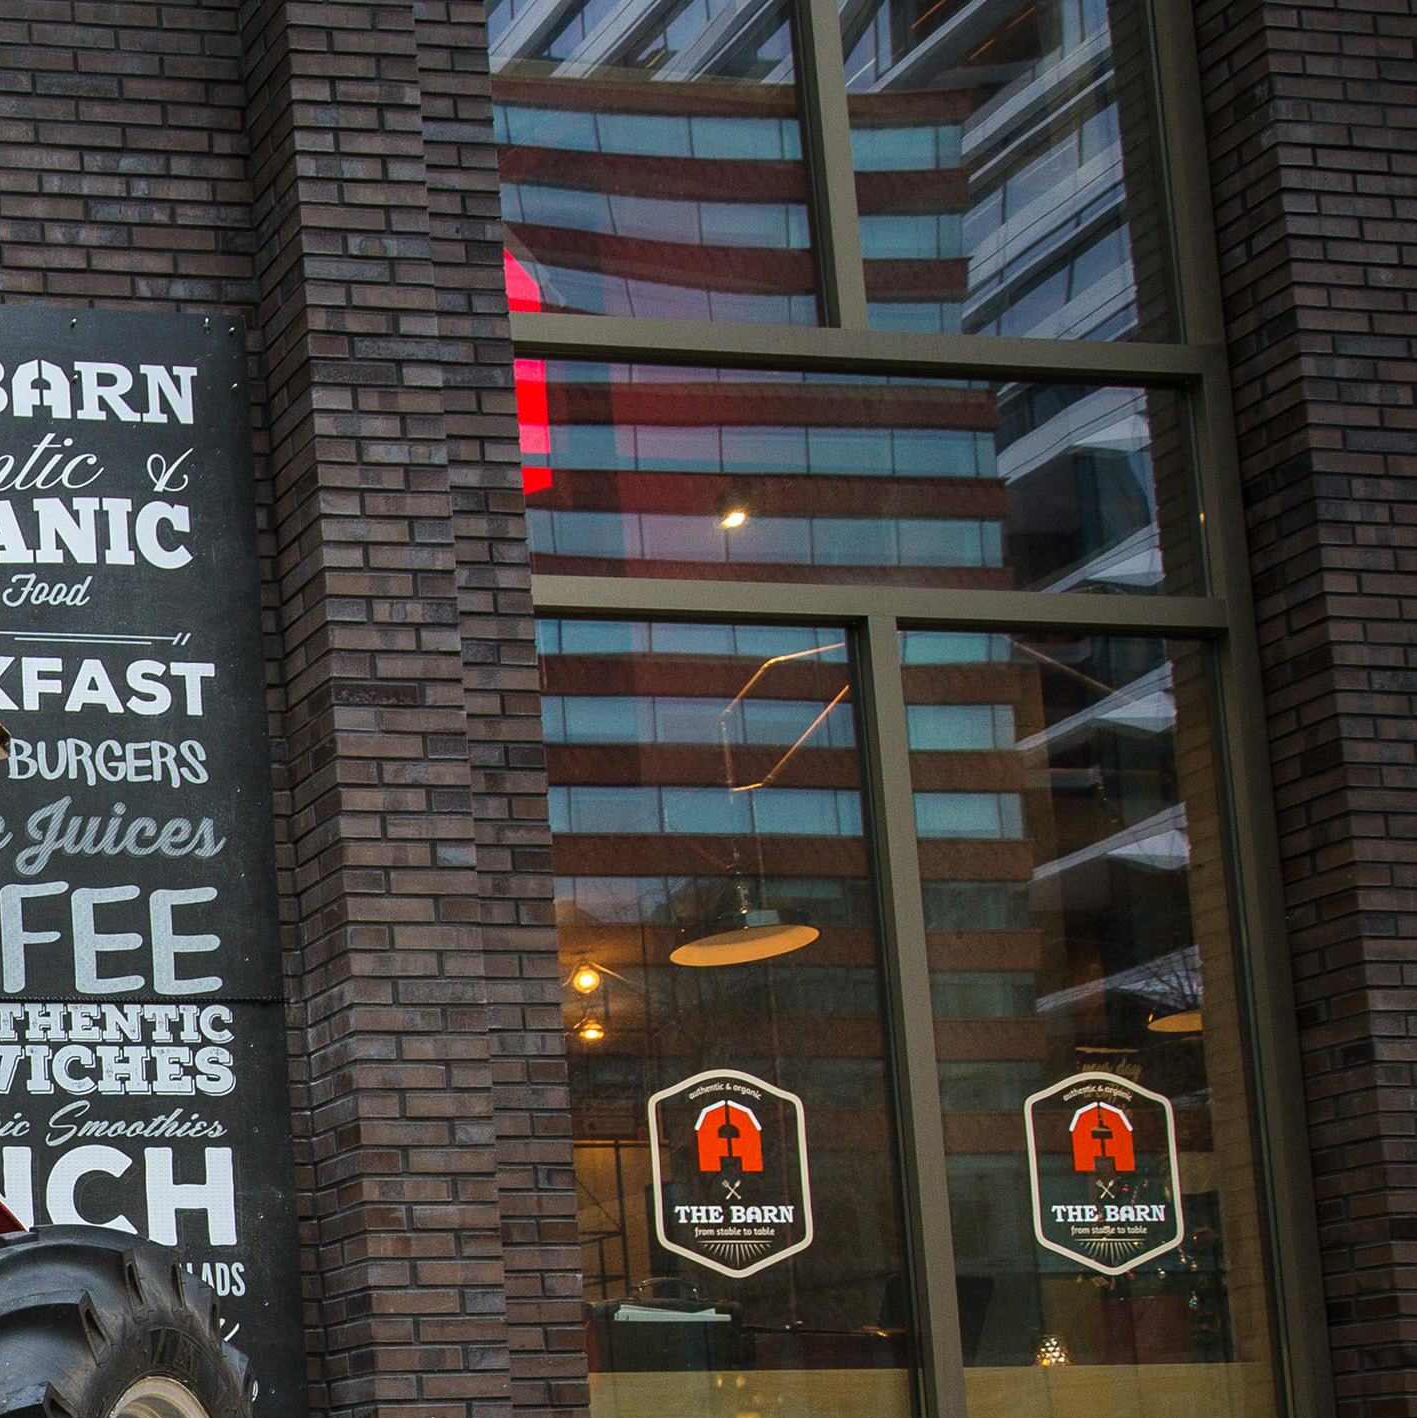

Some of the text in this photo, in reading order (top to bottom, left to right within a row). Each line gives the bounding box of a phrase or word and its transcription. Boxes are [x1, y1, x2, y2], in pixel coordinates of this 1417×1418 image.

[146, 447, 194, 492] &
[2, 572, 93, 607] Food
[8, 738, 209, 788] BURGERS
[16, 796, 226, 875] Juices
[688, 1082, 724, 1100] authentic
[733, 1085, 763, 1101] organic
[1062, 1085, 1096, 1102] authentic
[1104, 1086, 1133, 1102] organic
[45, 1100, 227, 1147] Smoothies
[674, 1205, 794, 1223] THE BARN
[1051, 1204, 1166, 1222] THE BARN
[694, 1226, 775, 1238] from stable to table
[1071, 1225, 1148, 1236] from stable to table
